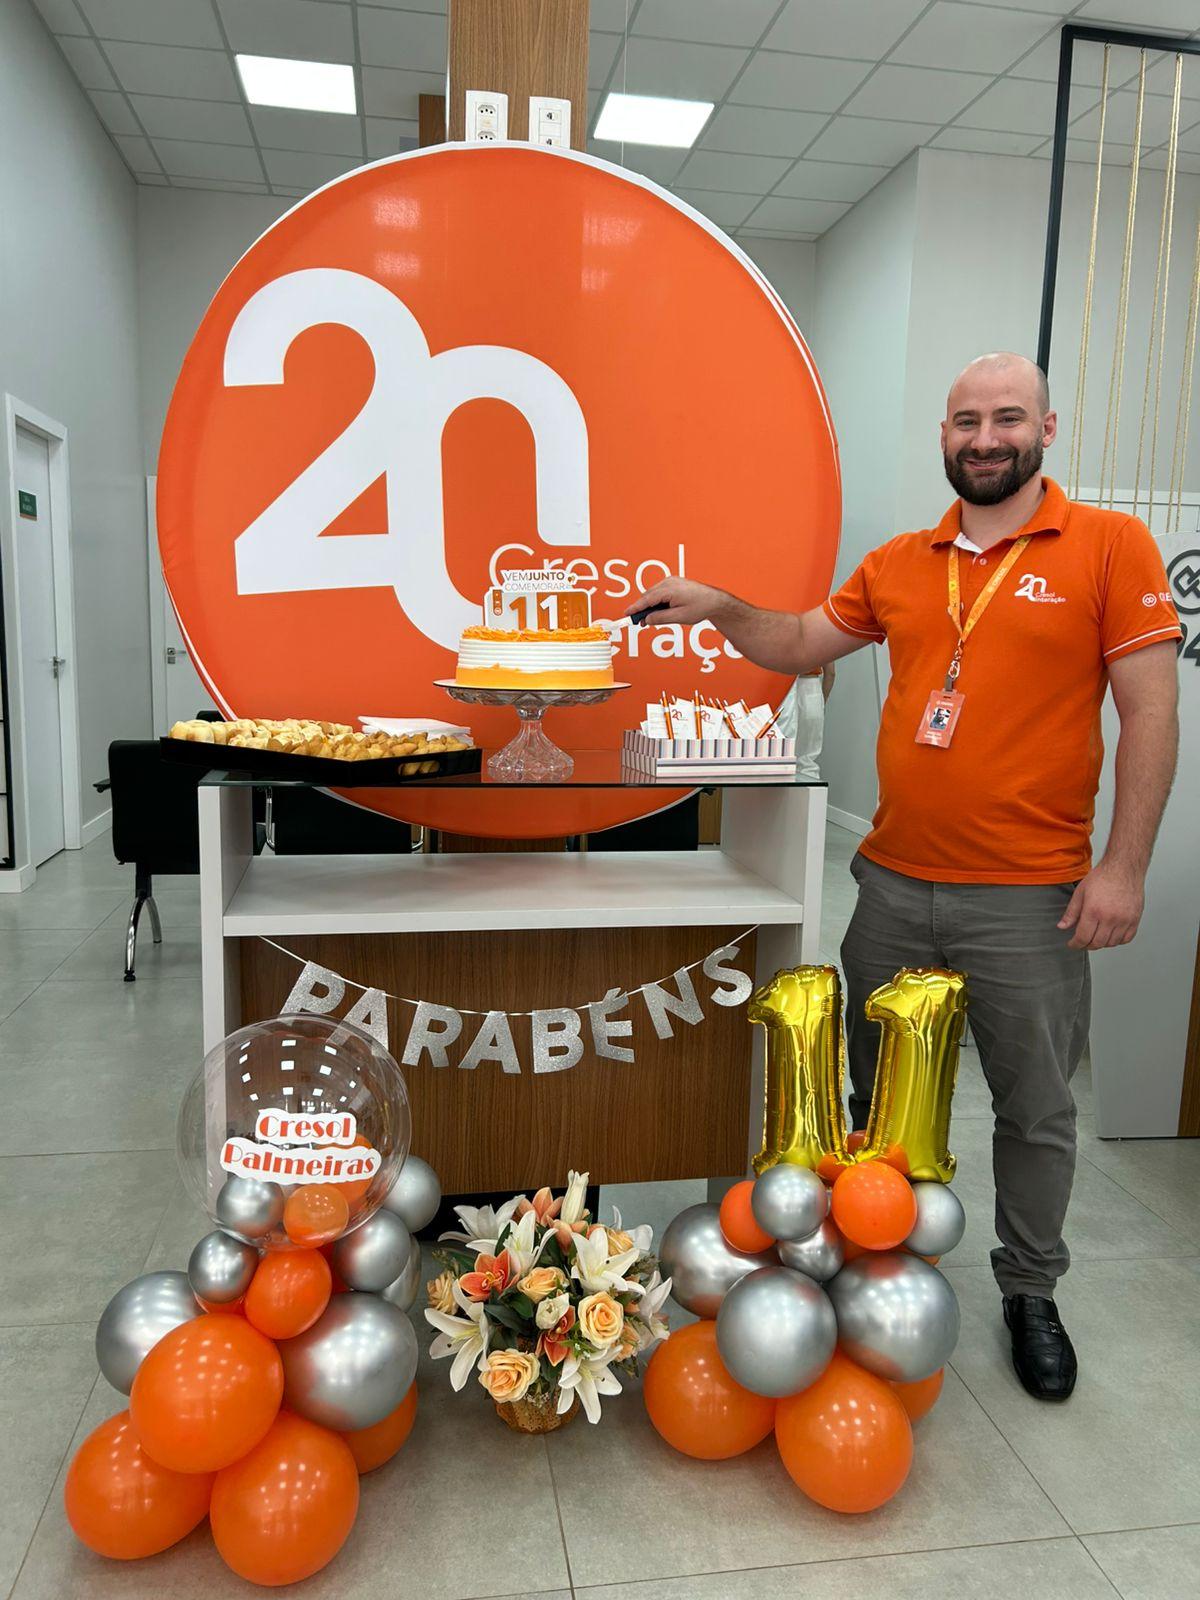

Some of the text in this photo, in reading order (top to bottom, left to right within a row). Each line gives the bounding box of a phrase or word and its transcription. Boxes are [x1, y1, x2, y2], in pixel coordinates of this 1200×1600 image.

[223, 267, 591, 653] 20
[509, 595, 558, 631] 11
[280, 945, 754, 1074] PARABÉNS
[259, 1115, 351, 1138] Cresol
[223, 1143, 375, 1177] Palmeiras
